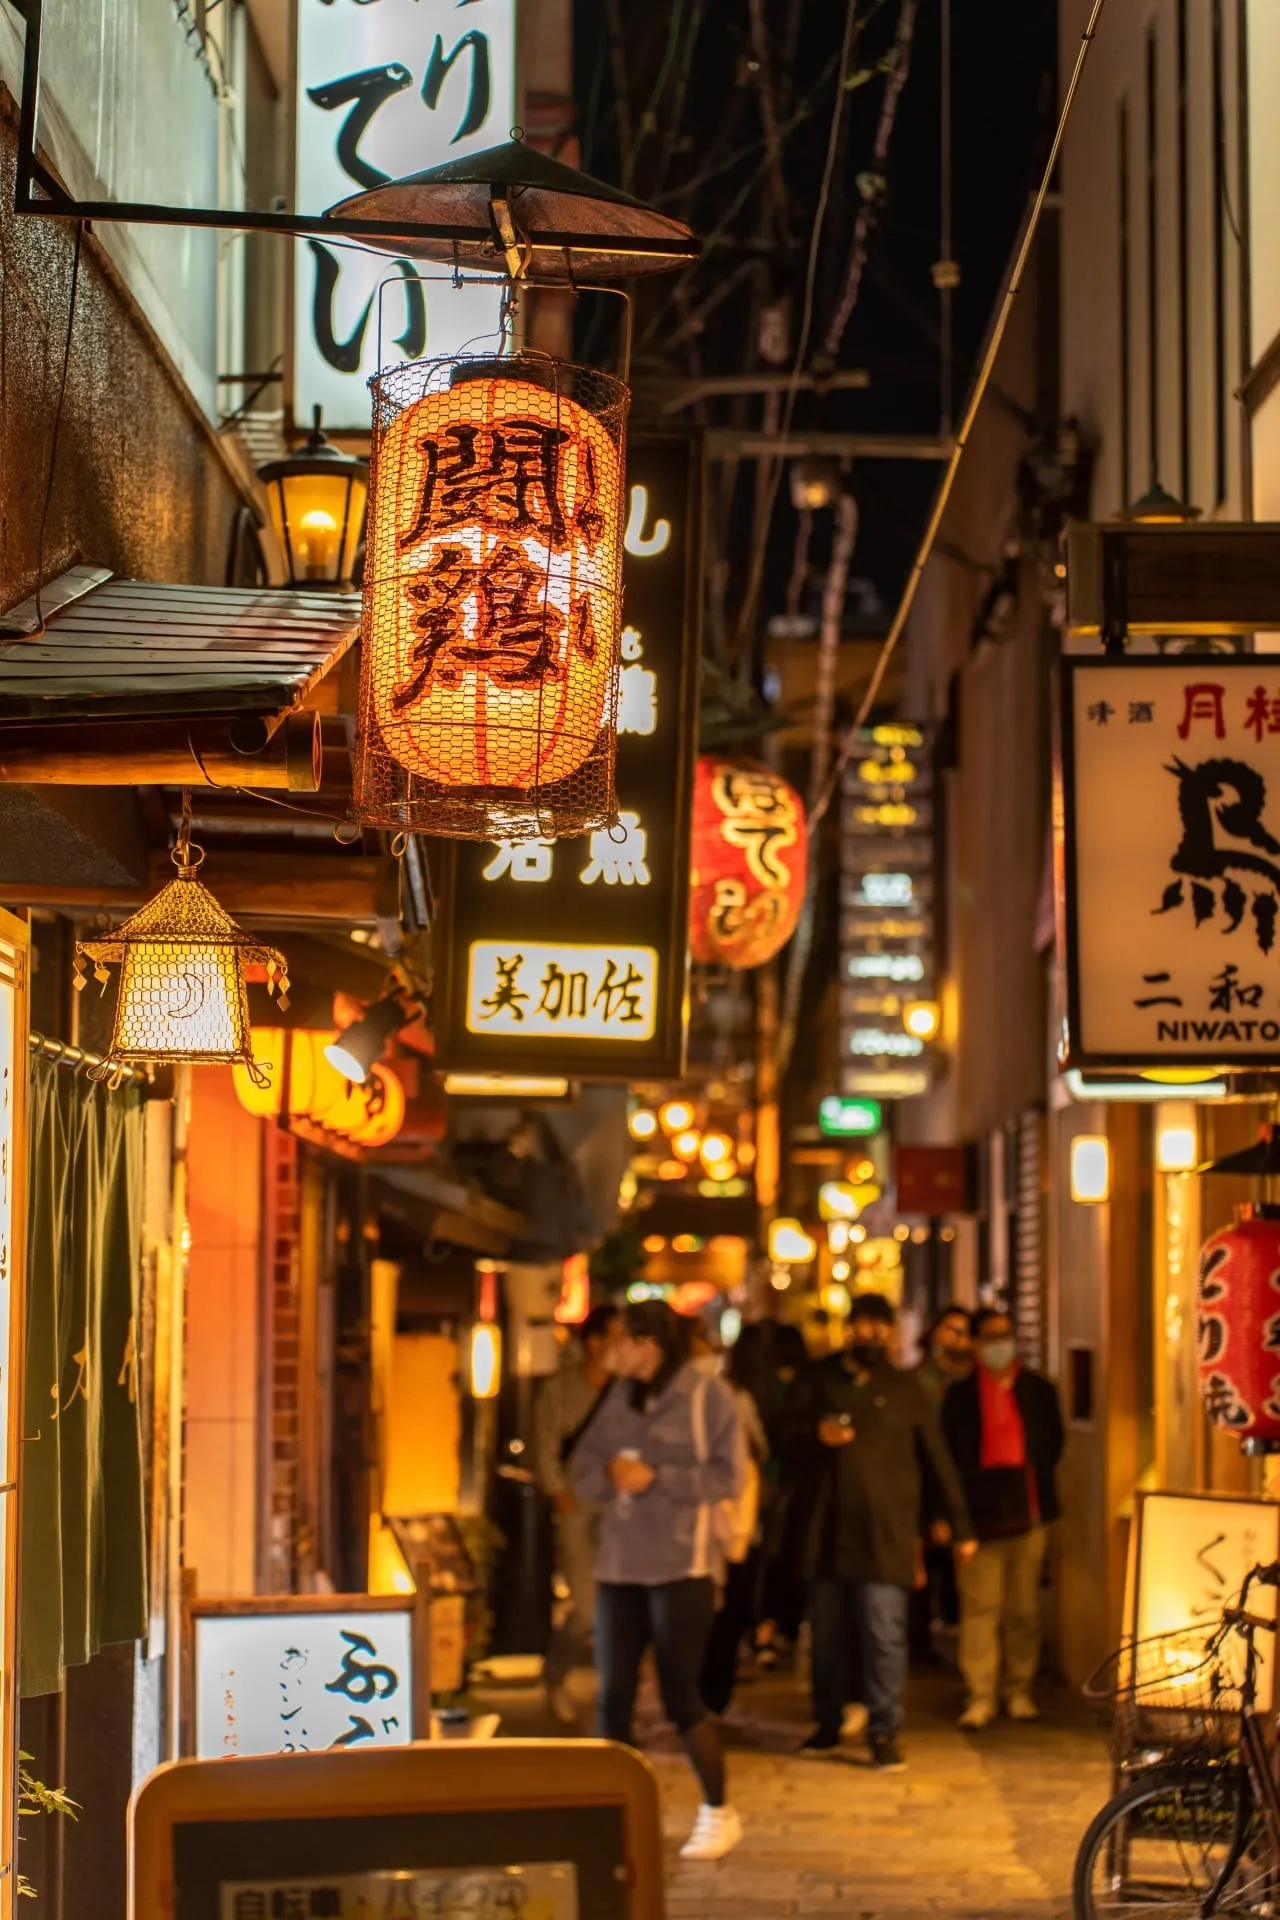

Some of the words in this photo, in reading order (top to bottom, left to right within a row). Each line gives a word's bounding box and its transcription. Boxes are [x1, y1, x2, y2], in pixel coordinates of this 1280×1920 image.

[306, 0, 426, 374] てい
[1133, 963, 1264, 1014] 二和
[1157, 1020, 1280, 1042] NIWATO
